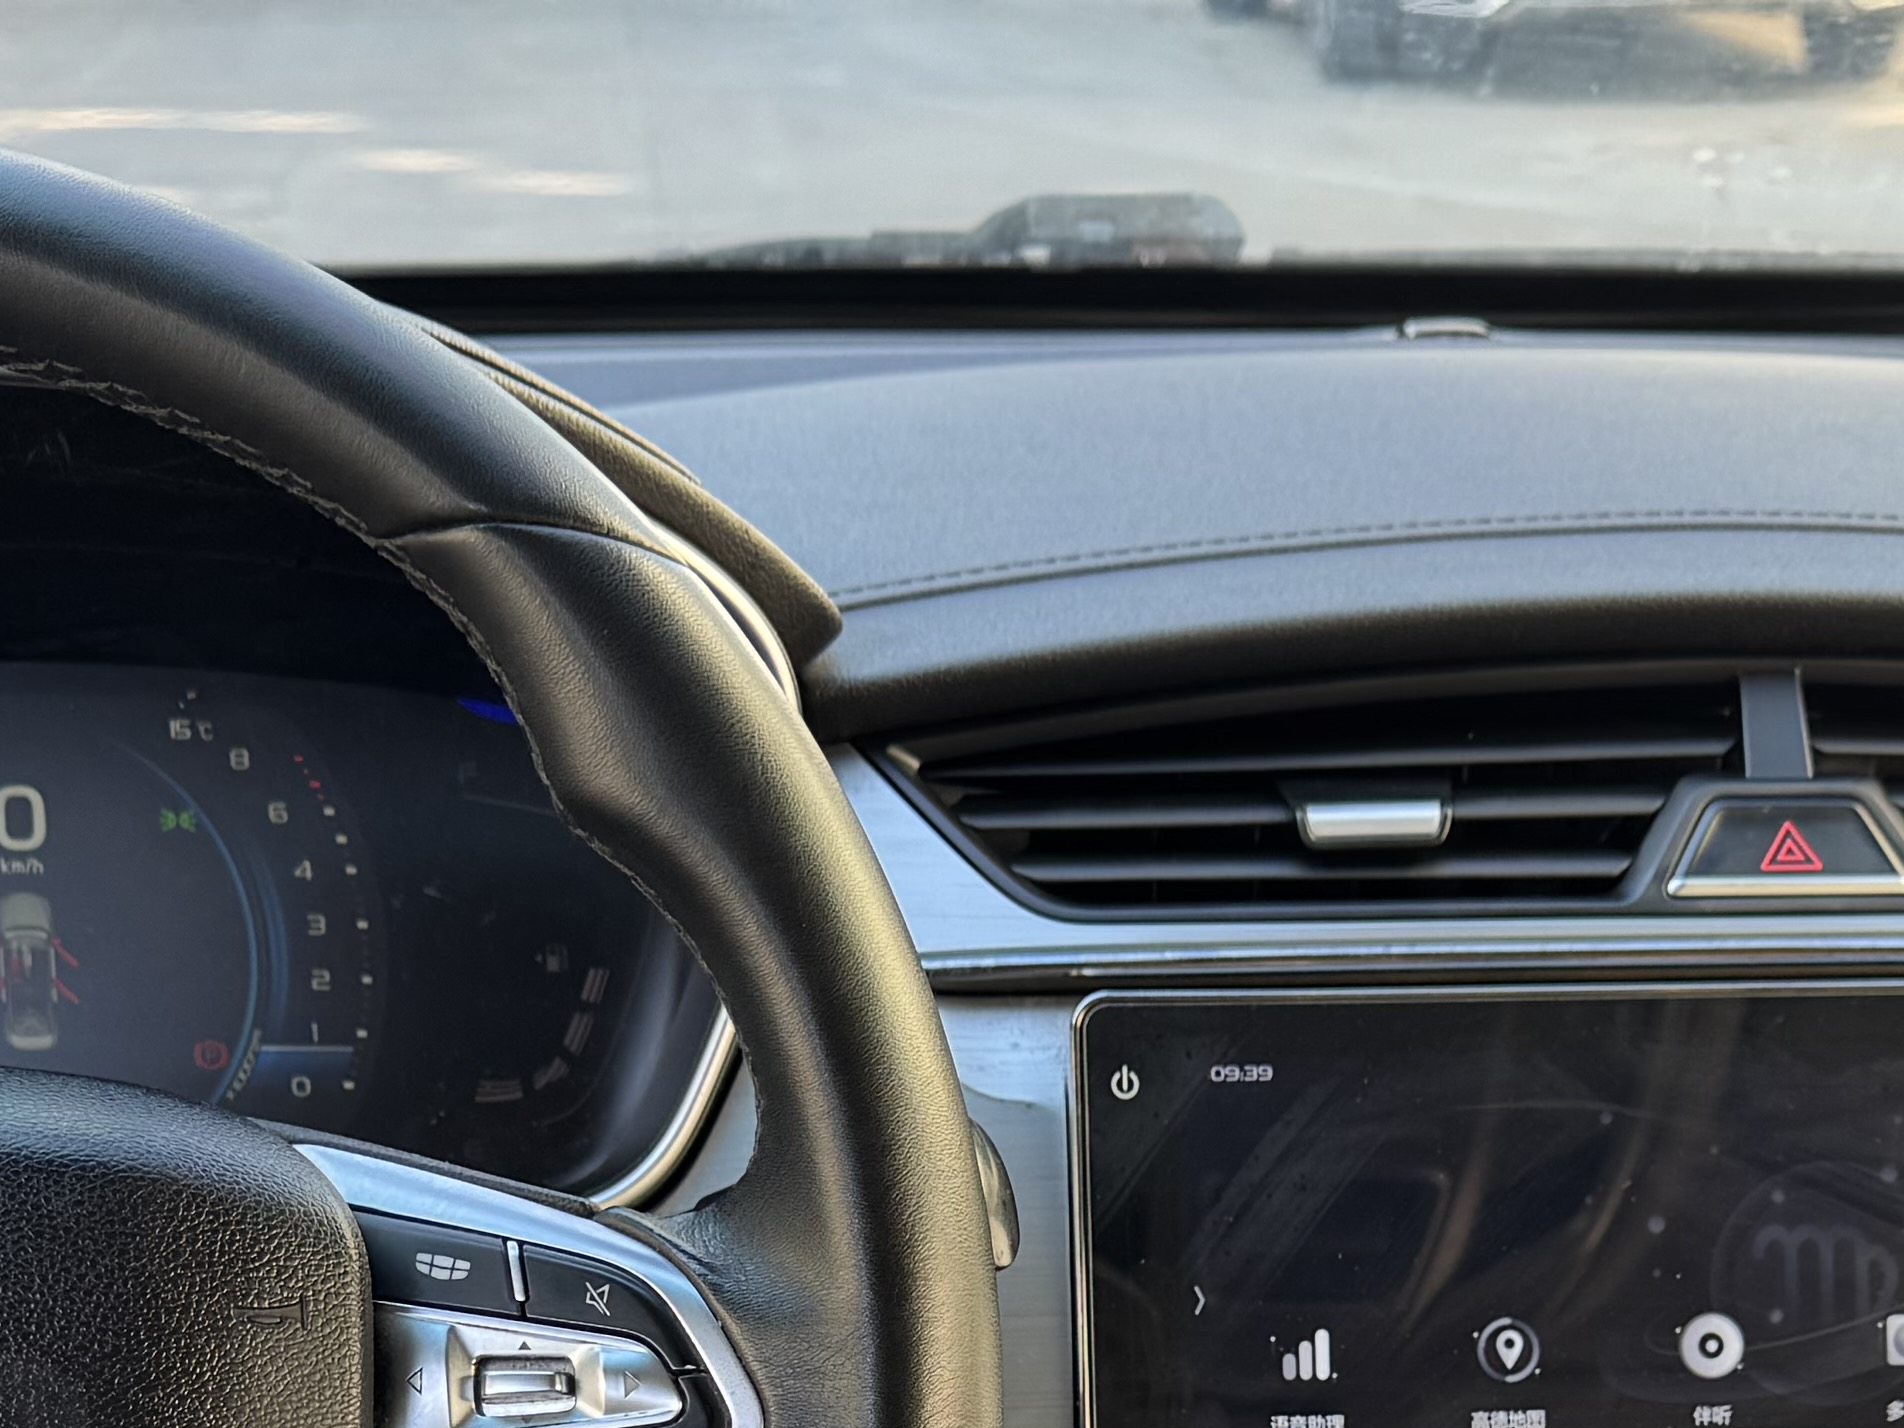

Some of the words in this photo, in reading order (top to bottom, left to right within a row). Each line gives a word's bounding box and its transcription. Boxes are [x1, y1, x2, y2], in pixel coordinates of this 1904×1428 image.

[169, 719, 191, 741] 15
[230, 748, 250, 770] 8
[269, 803, 288, 825] 6
[0, 857, 44, 876] km/h
[295, 861, 313, 880] 4
[308, 914, 326, 936] 3
[312, 969, 331, 991] 2
[1210, 1065, 1273, 1082] 09:39
[291, 1076, 312, 1097] 0
